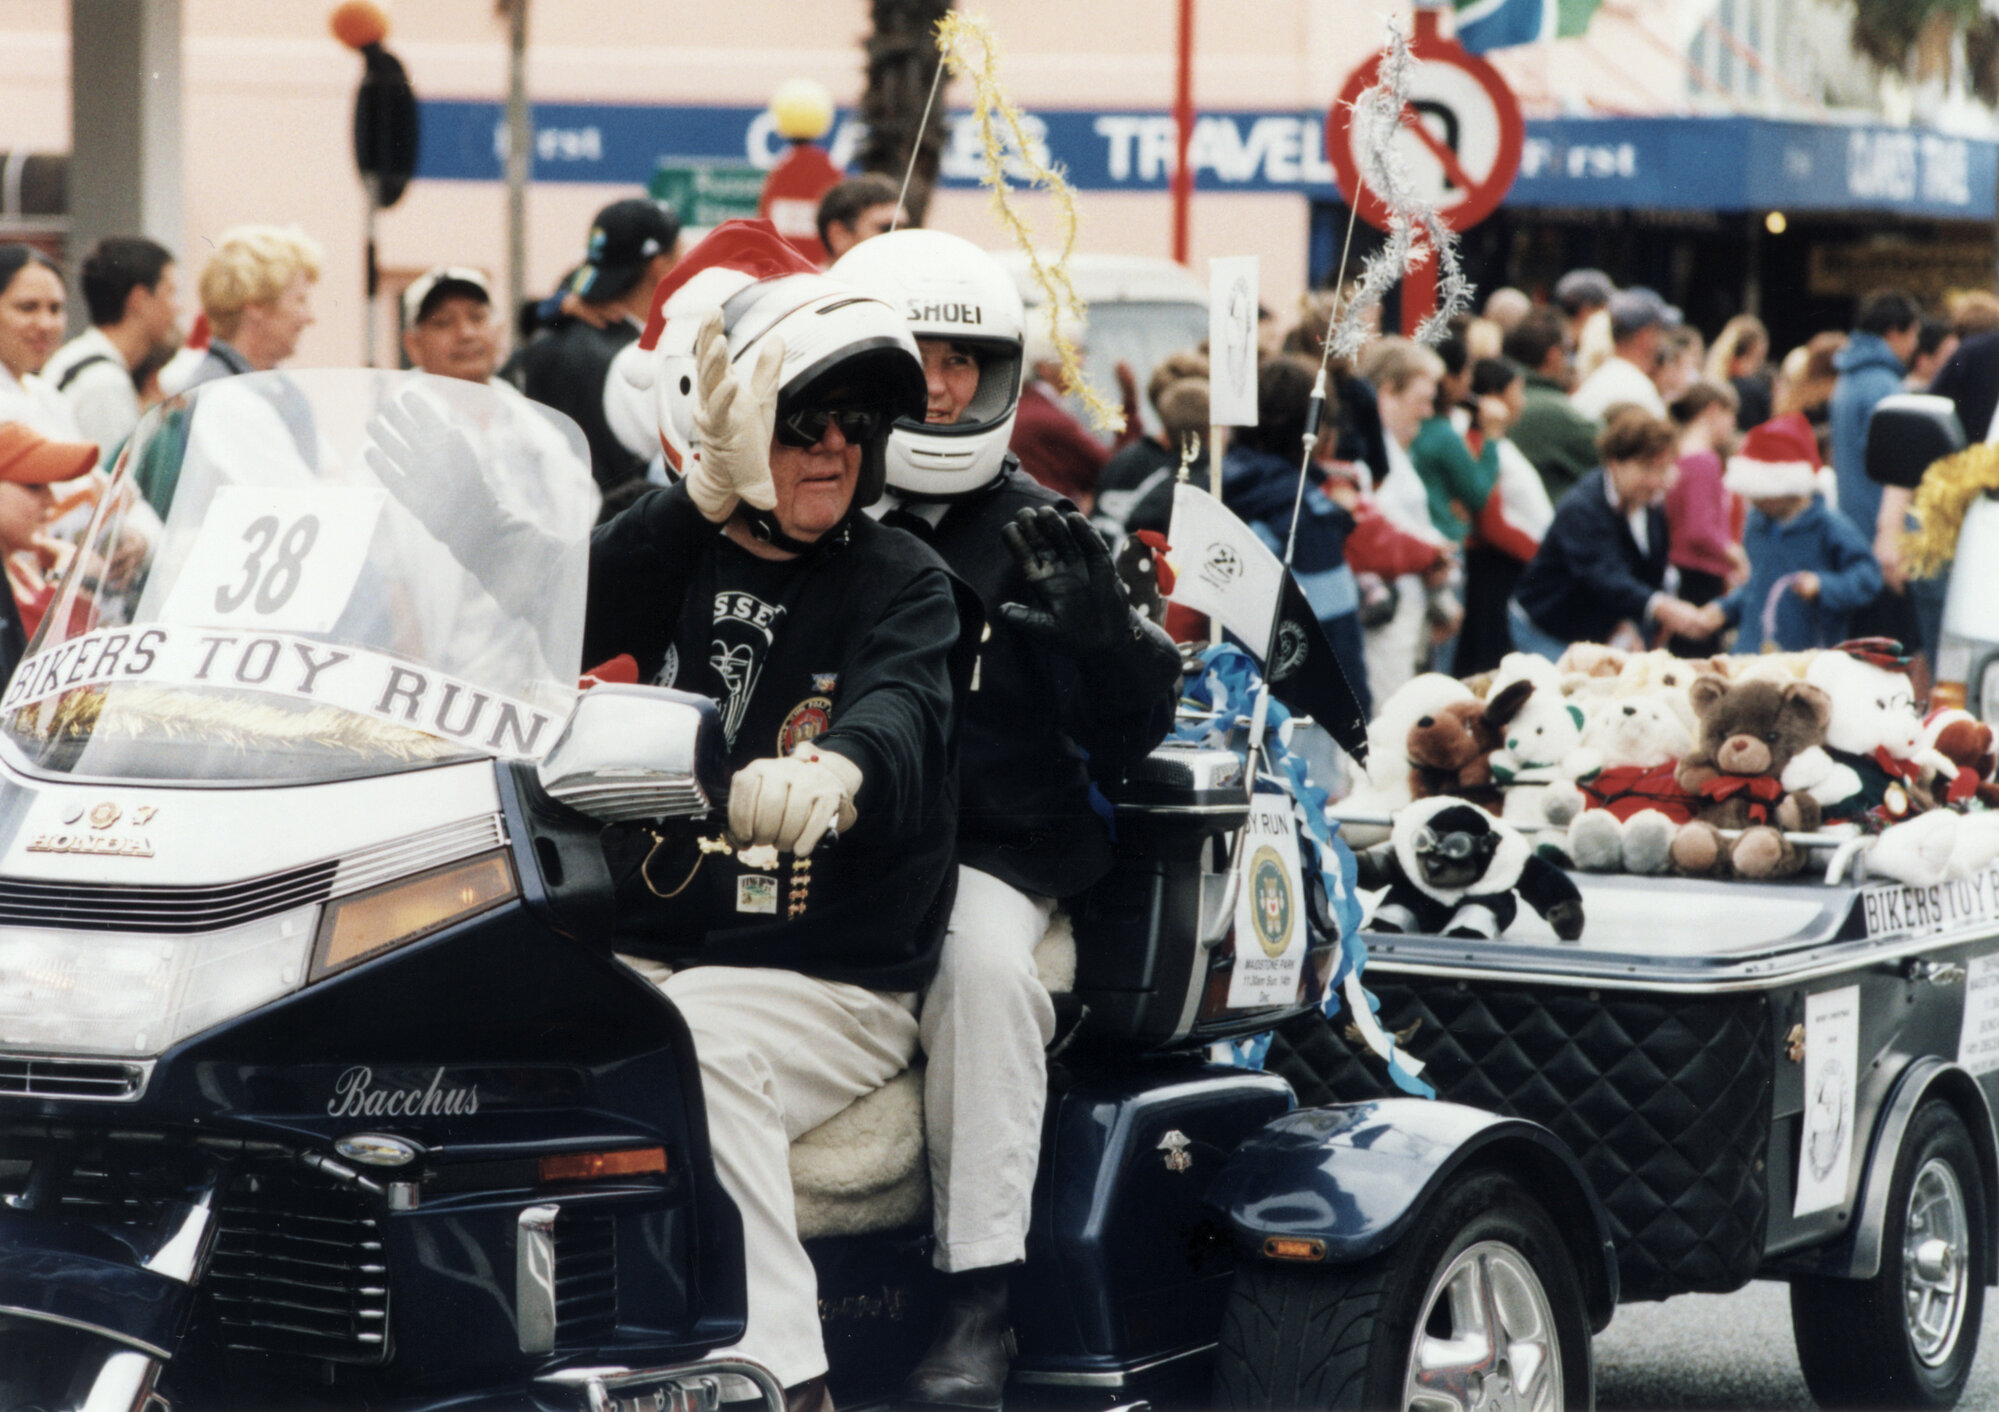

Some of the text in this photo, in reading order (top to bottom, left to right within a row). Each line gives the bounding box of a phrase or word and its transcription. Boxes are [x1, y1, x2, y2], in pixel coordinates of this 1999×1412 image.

[1093, 115, 1338, 184] TRAVEL
[906, 299, 982, 325] SHOEI
[214, 513, 321, 616] 38
[5, 629, 550, 755] BIKERS TOY RUN
[1261, 812, 1289, 835] RUN
[1866, 883, 1943, 935] BIKERS
[1943, 872, 1984, 919] TOY
[327, 1065, 479, 1117] Bacchus
